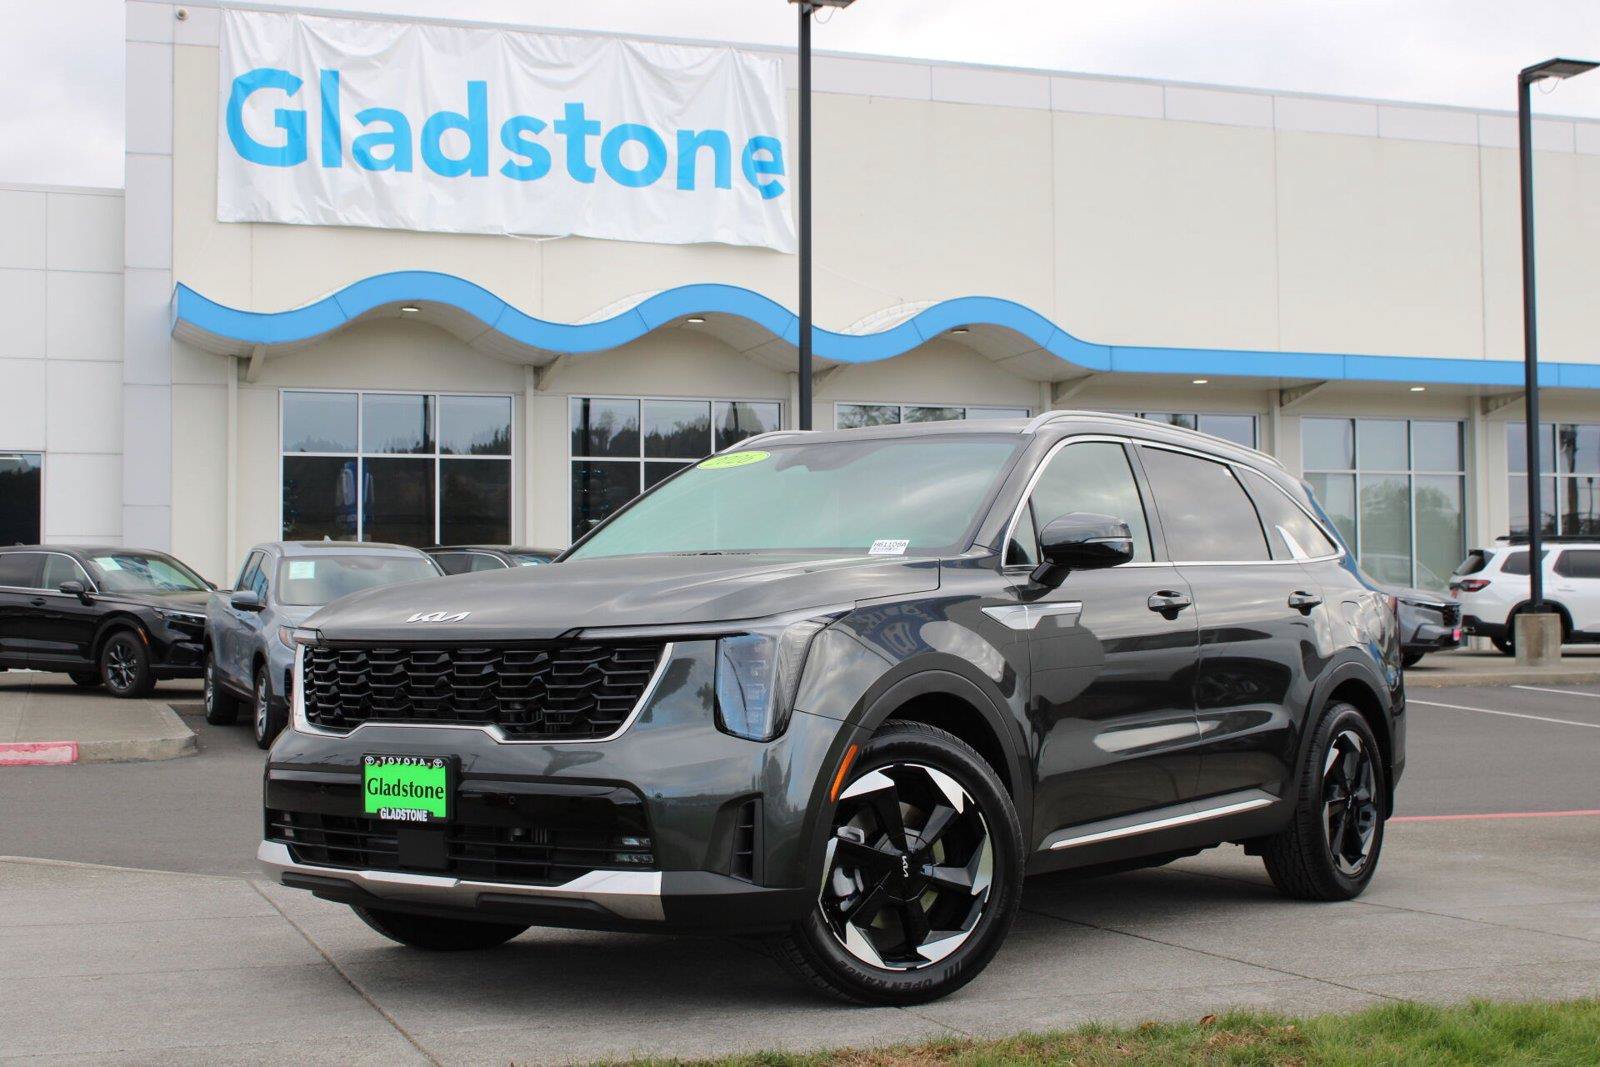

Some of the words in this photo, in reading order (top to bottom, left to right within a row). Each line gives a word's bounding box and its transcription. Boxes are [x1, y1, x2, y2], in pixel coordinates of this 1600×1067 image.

[226, 67, 787, 200] Gladstone
[405, 611, 472, 624] KIA
[381, 756, 426, 766] TOYOTA
[367, 777, 444, 799] Gladstone
[380, 808, 428, 822] GLADSTONE
